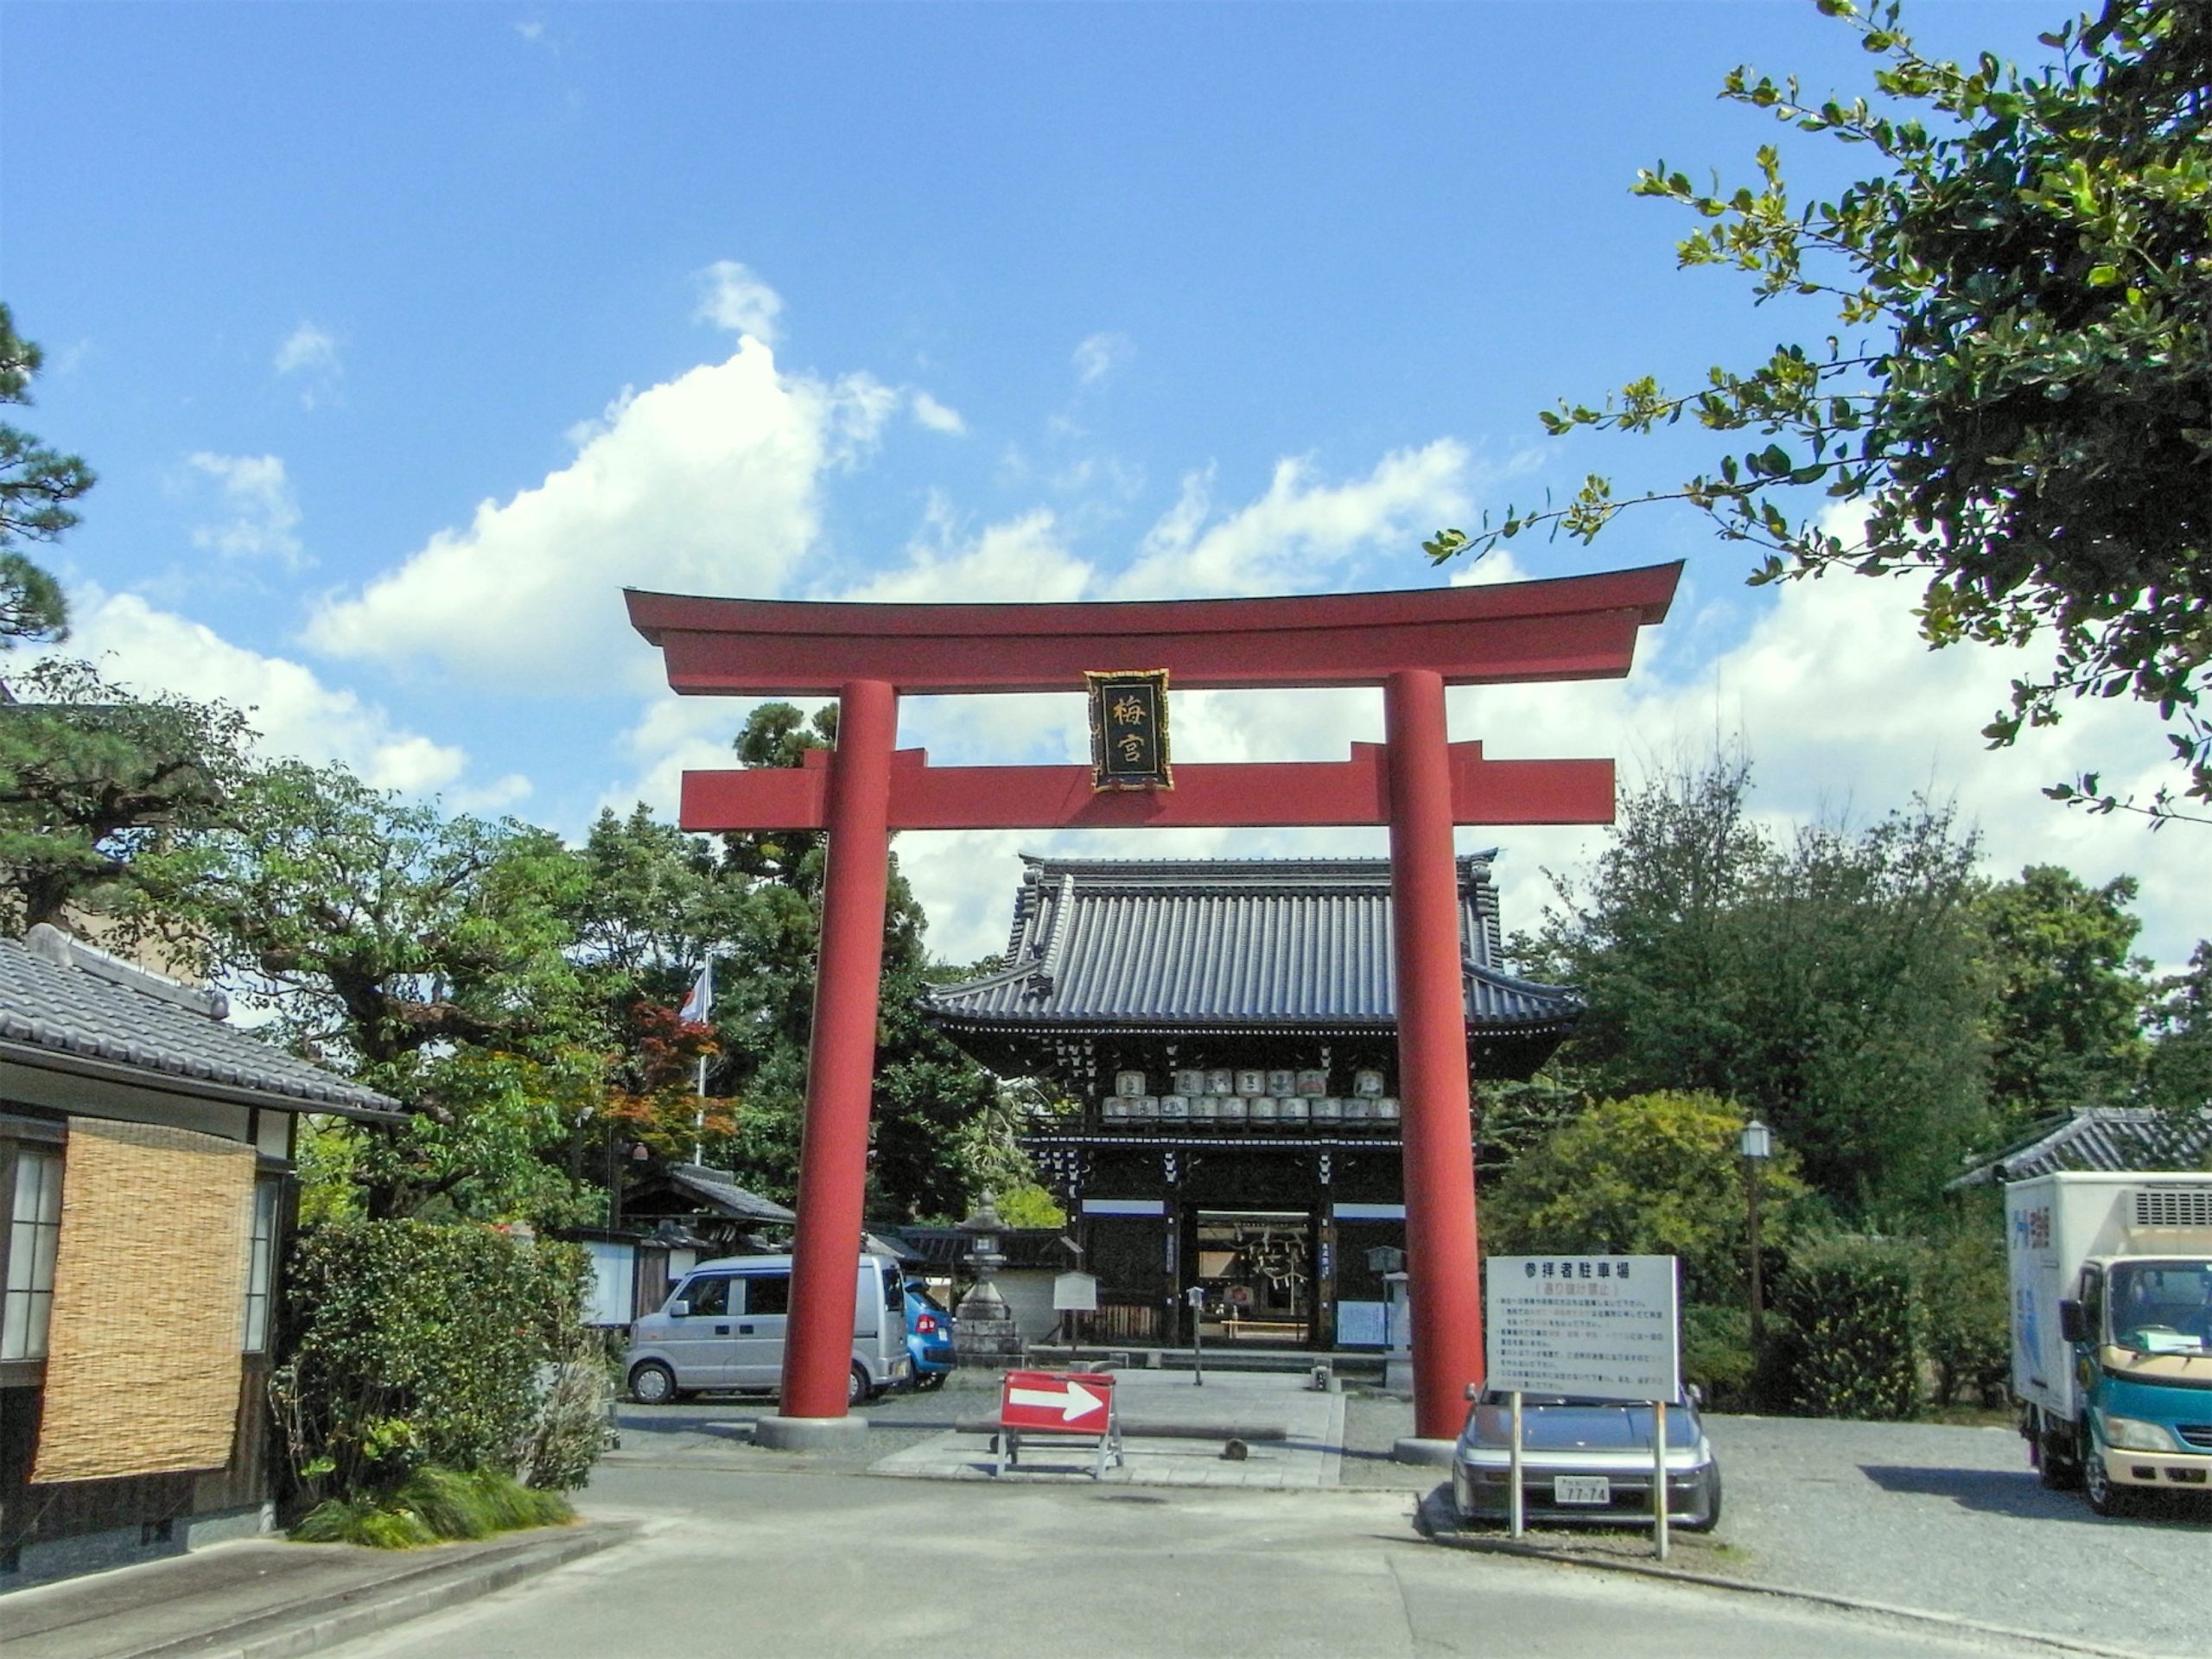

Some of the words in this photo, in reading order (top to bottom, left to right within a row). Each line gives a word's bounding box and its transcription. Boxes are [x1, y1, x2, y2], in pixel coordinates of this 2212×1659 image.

[1113, 695, 1147, 763] 梅宮
[1524, 1262, 1630, 1279] 参拝者駐車場
